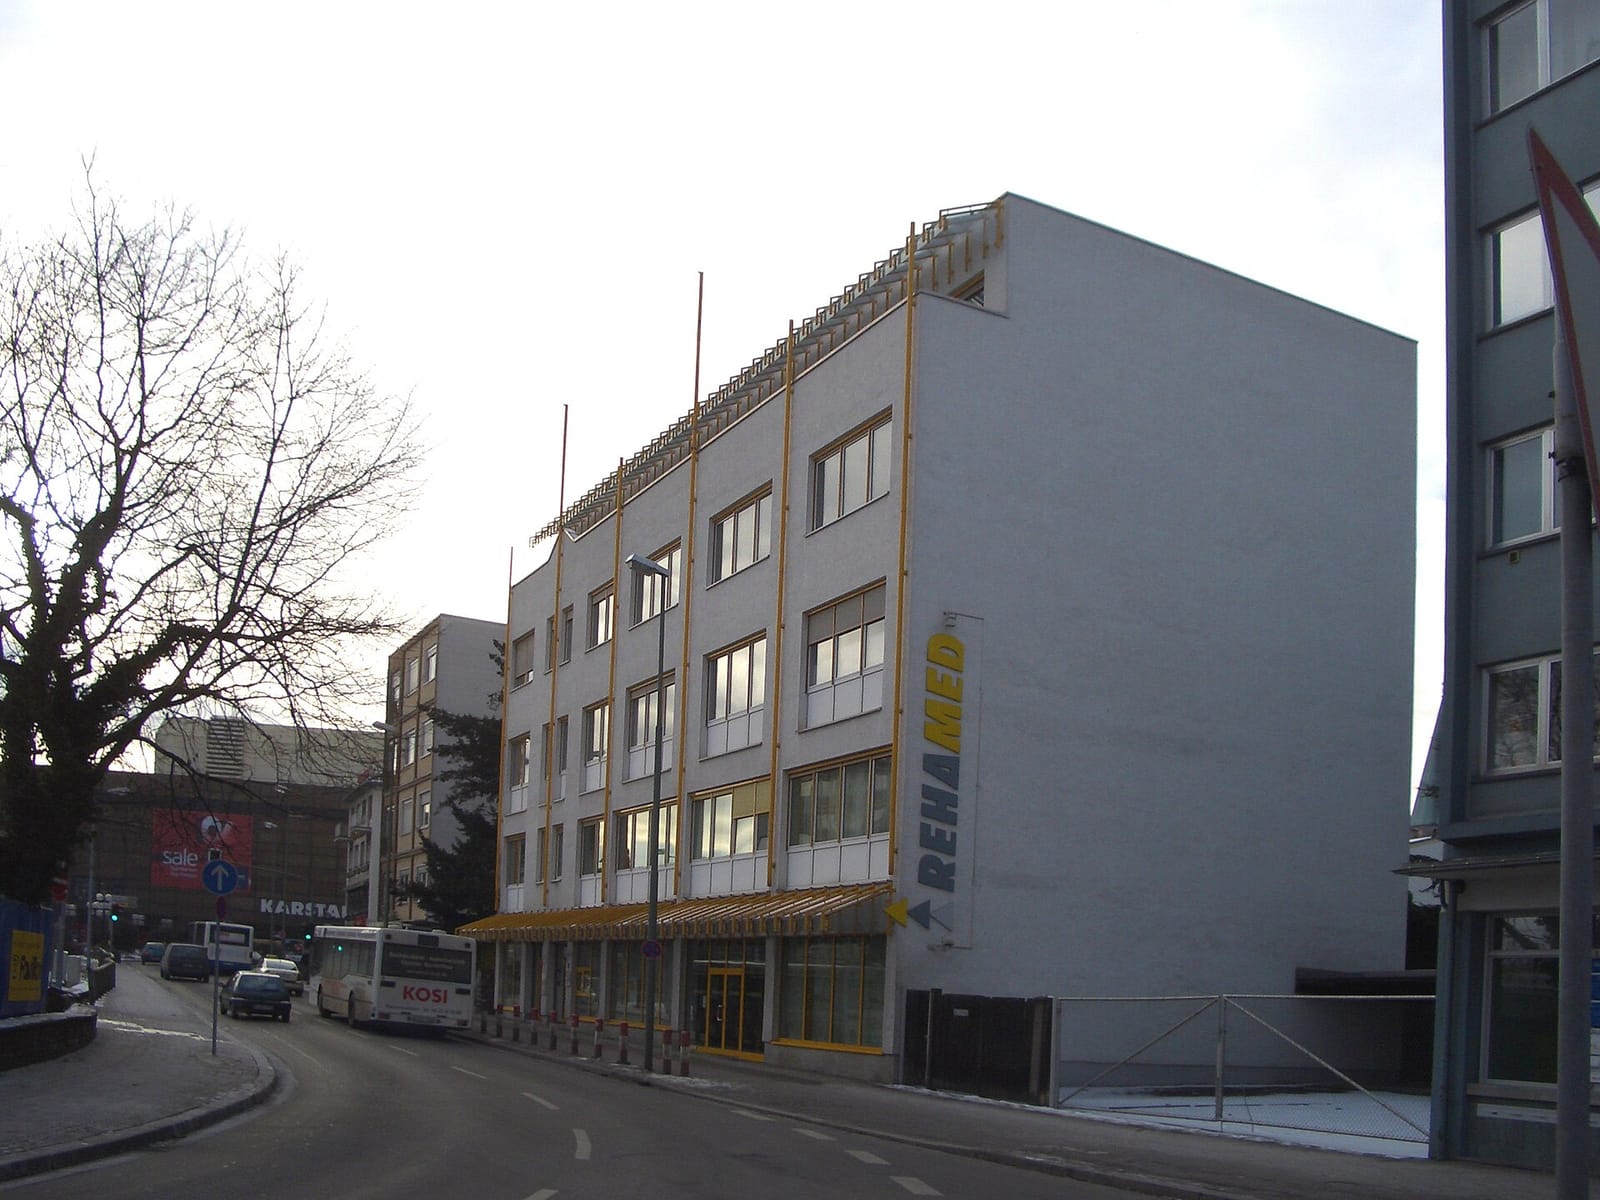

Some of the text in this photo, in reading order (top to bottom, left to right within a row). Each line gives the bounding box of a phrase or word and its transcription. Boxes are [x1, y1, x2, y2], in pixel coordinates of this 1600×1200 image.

[919, 633, 965, 892] REHAMED
[163, 848, 198, 866] sale
[403, 985, 448, 1004] KOSI
